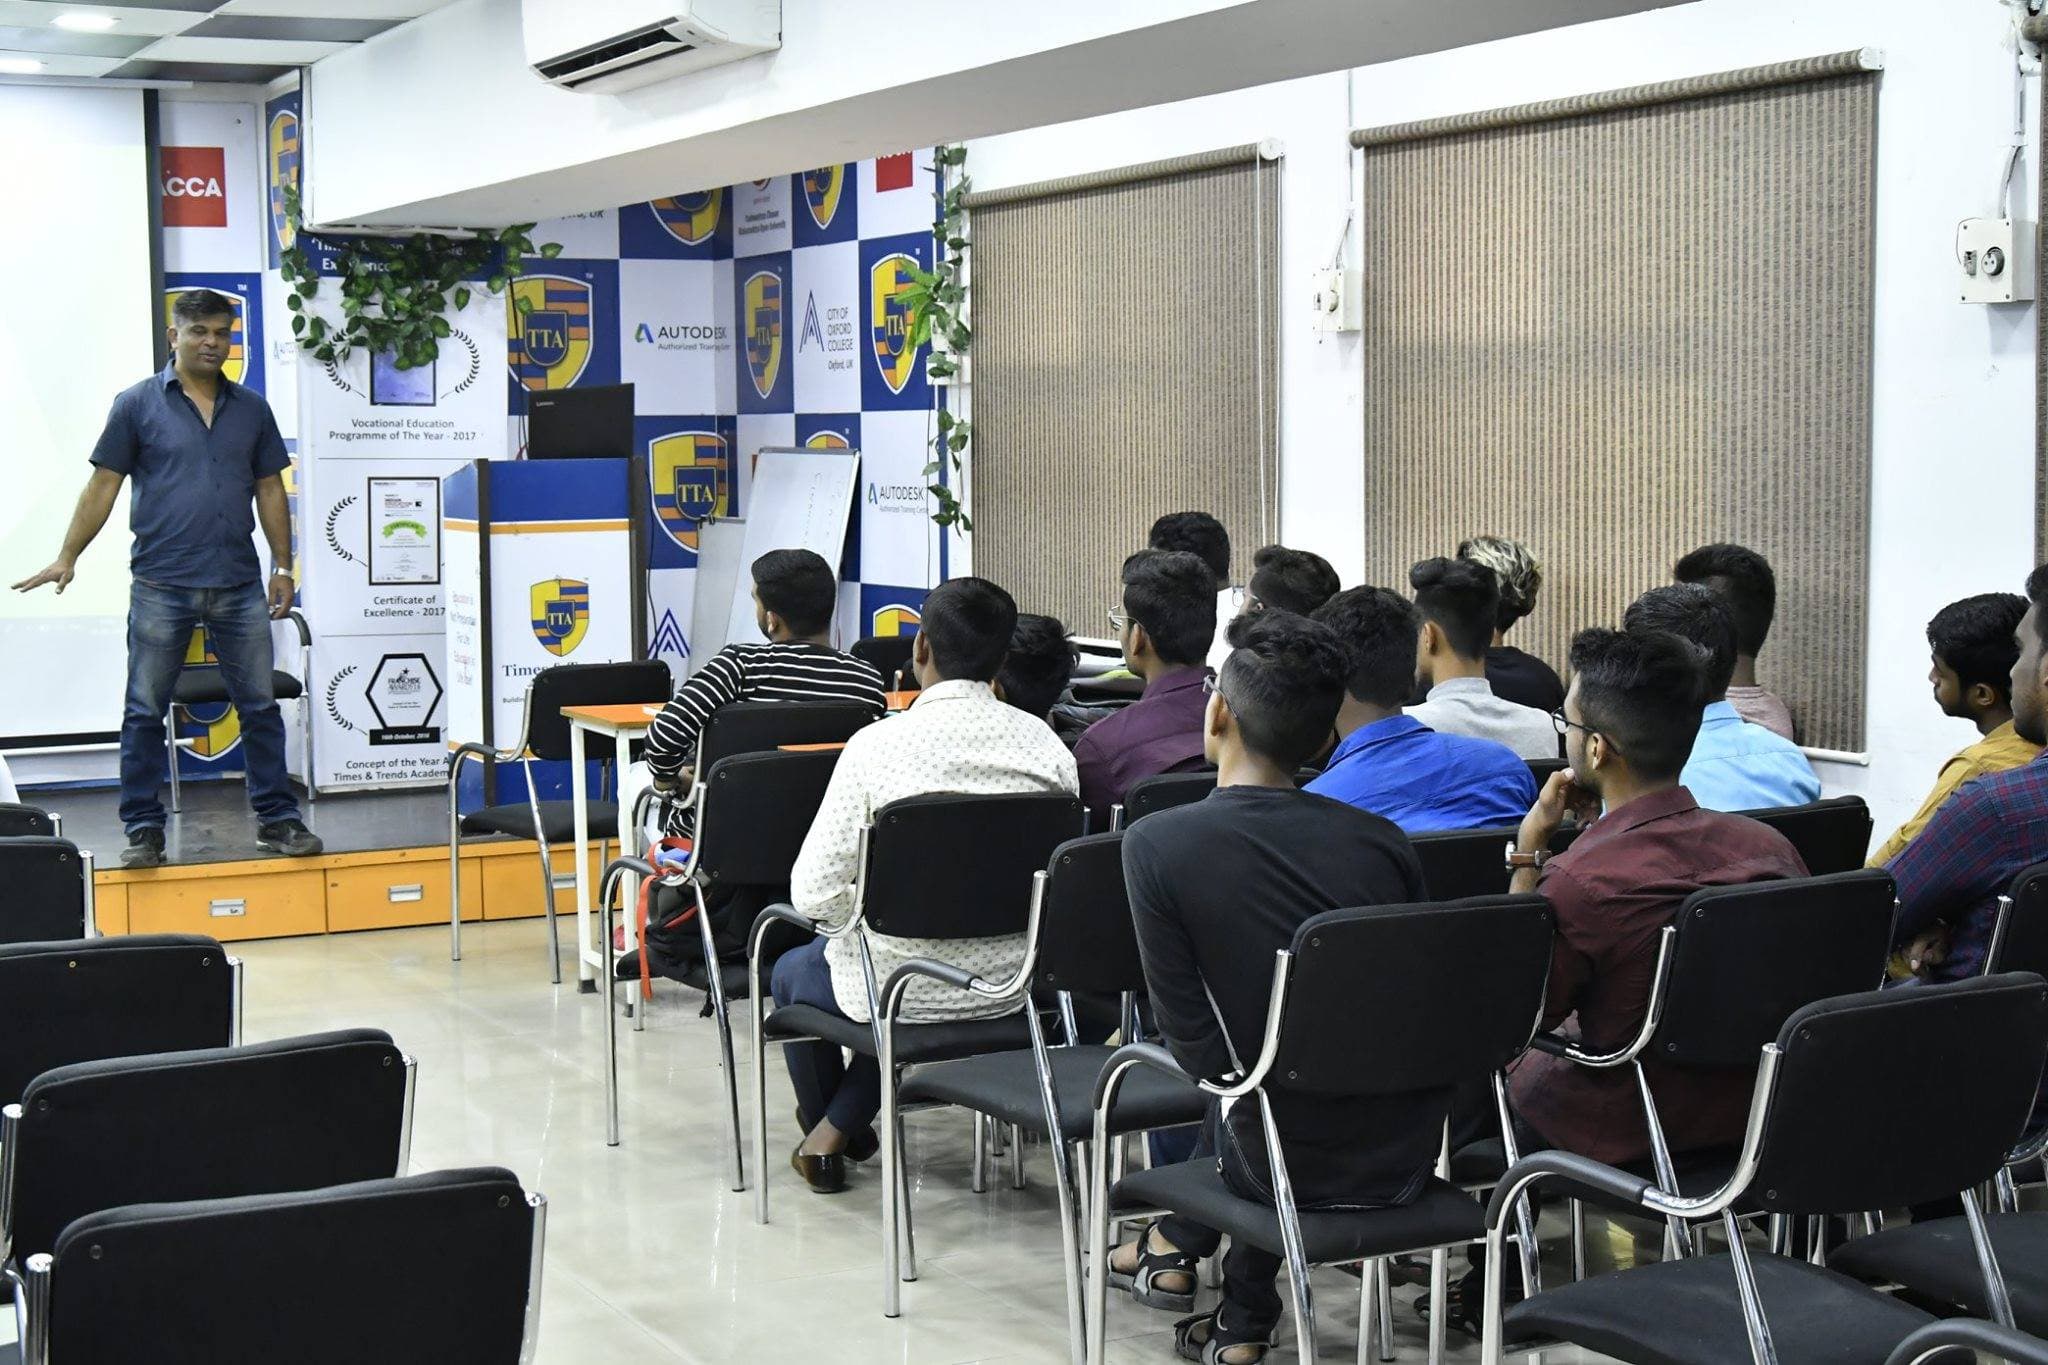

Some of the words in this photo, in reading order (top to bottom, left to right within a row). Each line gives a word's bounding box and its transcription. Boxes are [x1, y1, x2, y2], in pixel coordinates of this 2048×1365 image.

[827, 308, 840, 320] CITY
[840, 307, 848, 319] OF
[827, 322, 852, 336] OXFORD
[887, 314, 905, 336] TTA
[527, 328, 564, 348] TTA
[658, 326, 727, 339] AUTODESK
[827, 338, 853, 352] COLLEGE
[352, 418, 404, 428] Vocational
[407, 418, 454, 428] Education
[329, 431, 387, 441] Programme
[389, 431, 400, 440] of
[403, 431, 420, 440] The
[423, 431, 444, 440] Year
[453, 431, 476, 440] 2017
[679, 483, 714, 502] TTA
[880, 486, 924, 500] AUTODESK
[374, 595, 423, 605] Certificate
[426, 595, 436, 604] of
[363, 607, 414, 617] Excellence
[422, 607, 446, 616] 2017
[548, 612, 572, 625] TTA
[346, 760, 386, 769] Concept
[388, 759, 398, 768] of
[401, 758, 417, 767] the
[420, 758, 440, 766] Year
[333, 772, 362, 781] Times
[365, 771, 373, 780] &
[376, 769, 408, 779] Trends
[411, 769, 449, 778] Academ
